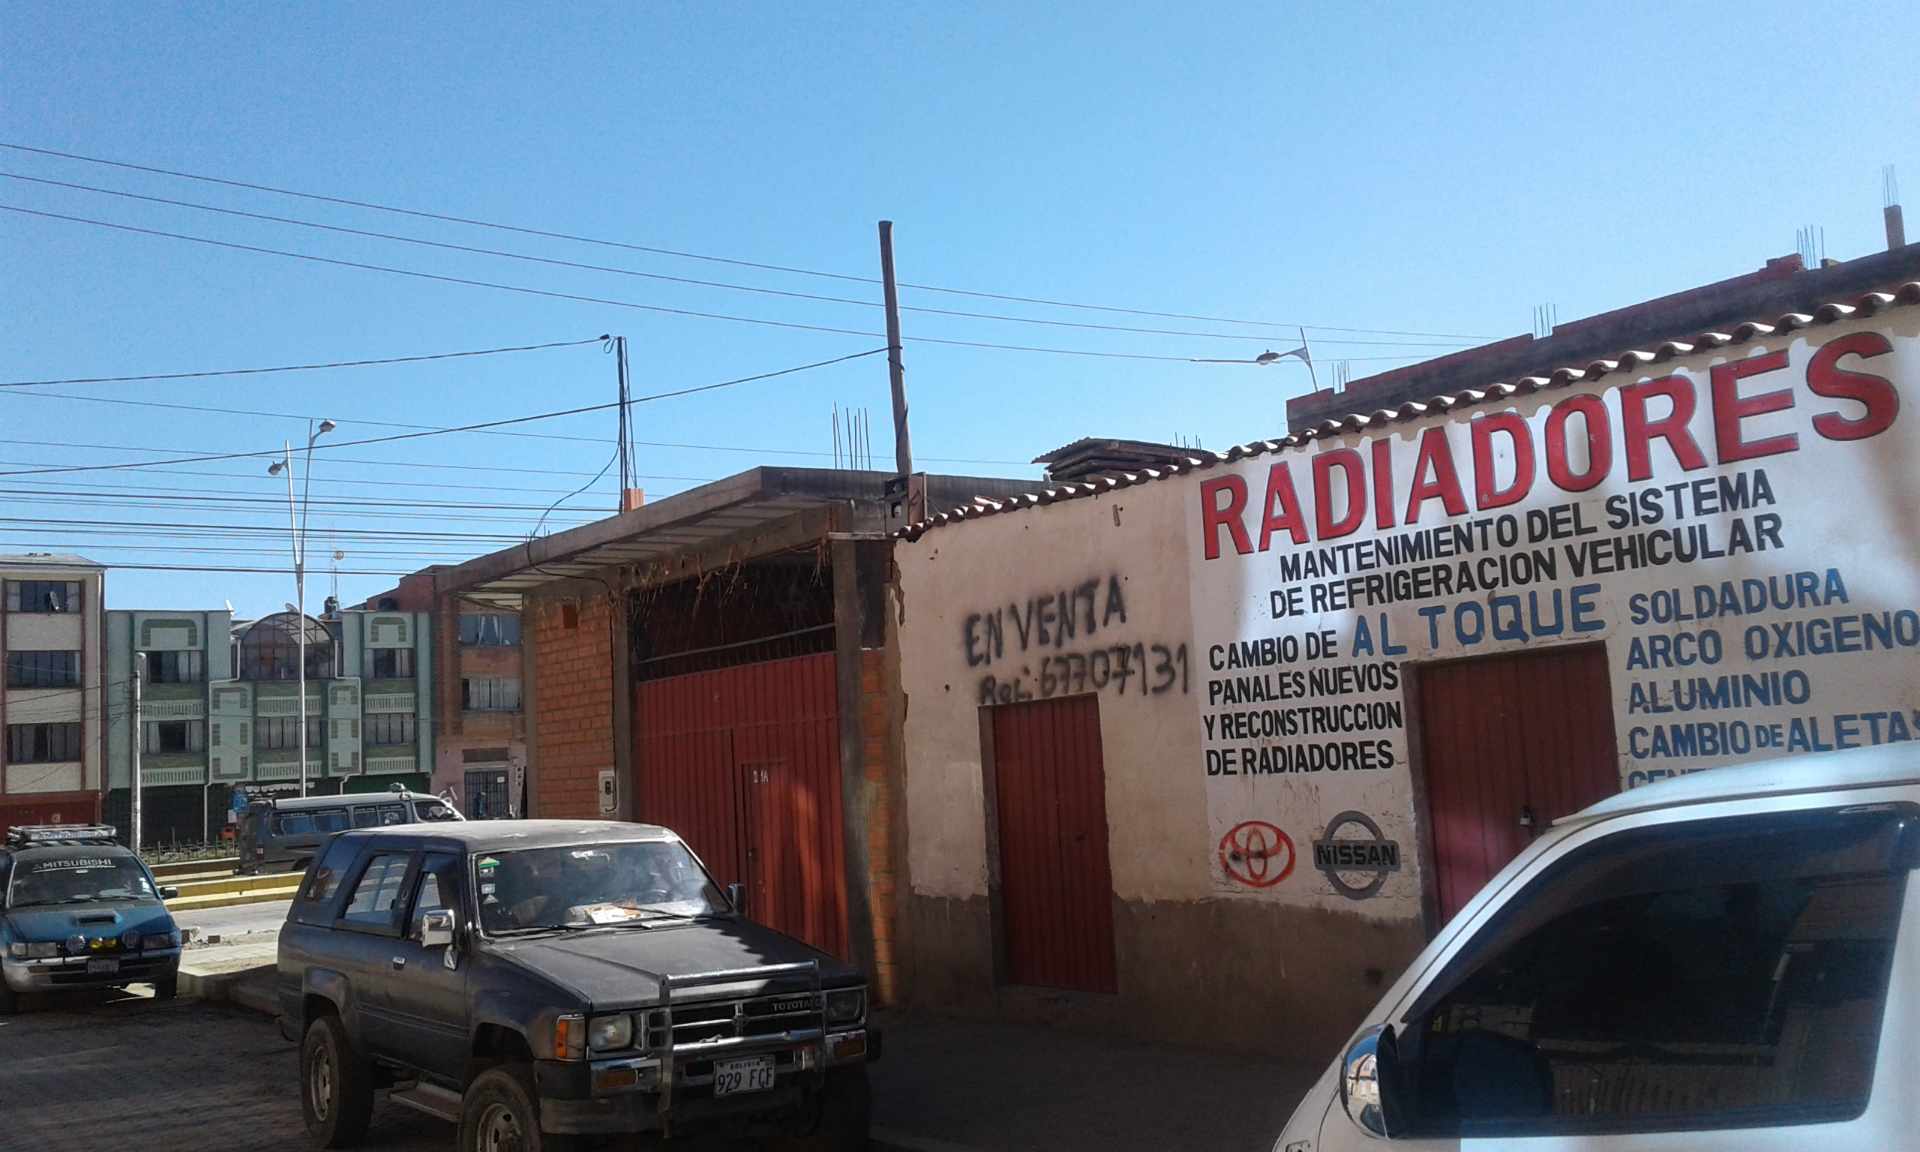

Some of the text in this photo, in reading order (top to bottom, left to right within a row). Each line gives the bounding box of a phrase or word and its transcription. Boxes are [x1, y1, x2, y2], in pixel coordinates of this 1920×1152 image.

[1200, 331, 1899, 560] RADIADORES
[1280, 469, 1775, 582] MANTENIMIENTO DEL SISTEMA
[1270, 513, 1784, 619] DE REFRIGERACION VEHICULAR
[1629, 568, 1849, 625] SOLDADURA
[964, 575, 1127, 666] EN VENTA
[1352, 583, 1605, 657] AL TOQUE
[1626, 609, 1919, 670] ARCO OXIGENO
[1041, 642, 1189, 697] 67707131
[1209, 630, 1338, 671] CAMBIO DE
[1208, 662, 1399, 706] PANALES NUEVOS
[1628, 669, 1811, 714] ALUMINIO
[1203, 701, 1402, 740] Y RECONSTRUCCION
[1629, 721, 1750, 759] CAMBIO
[1755, 724, 1785, 748] DE
[1206, 740, 1394, 776] DE RADIADORES
[42, 859, 112, 870] MITSUBISHI
[1316, 844, 1396, 867] NISSAN
[719, 1072, 741, 1093] 929
